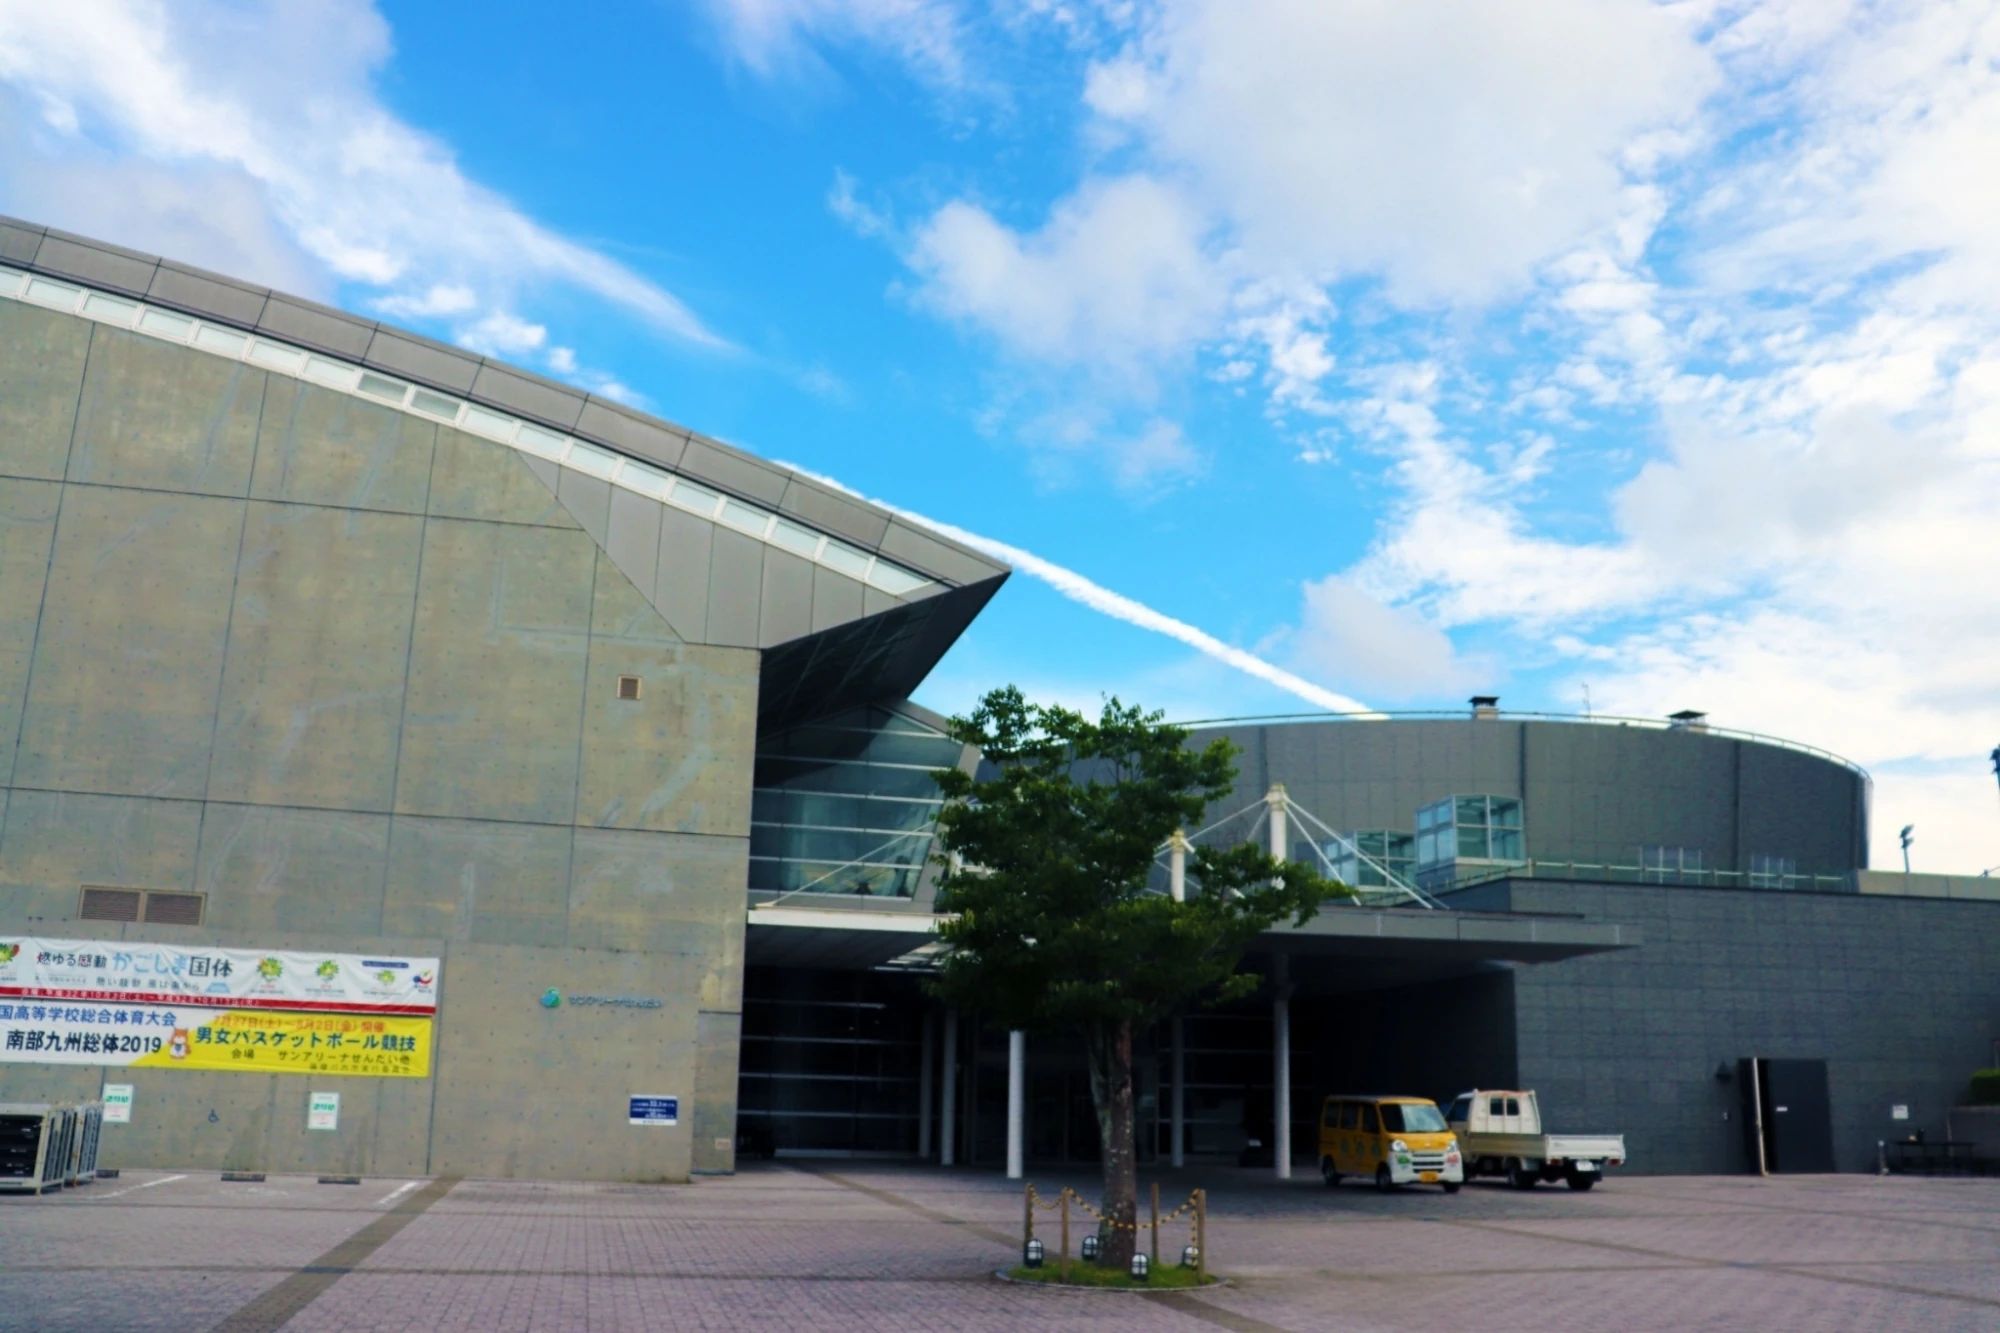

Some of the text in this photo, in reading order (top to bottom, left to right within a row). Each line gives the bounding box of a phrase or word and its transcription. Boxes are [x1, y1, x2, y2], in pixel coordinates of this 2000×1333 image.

[112, 951, 233, 978] かごしま国体
[6, 1029, 162, 1054] 南部九州総体2019
[195, 1026, 416, 1053] 男女バスケットボール競技
